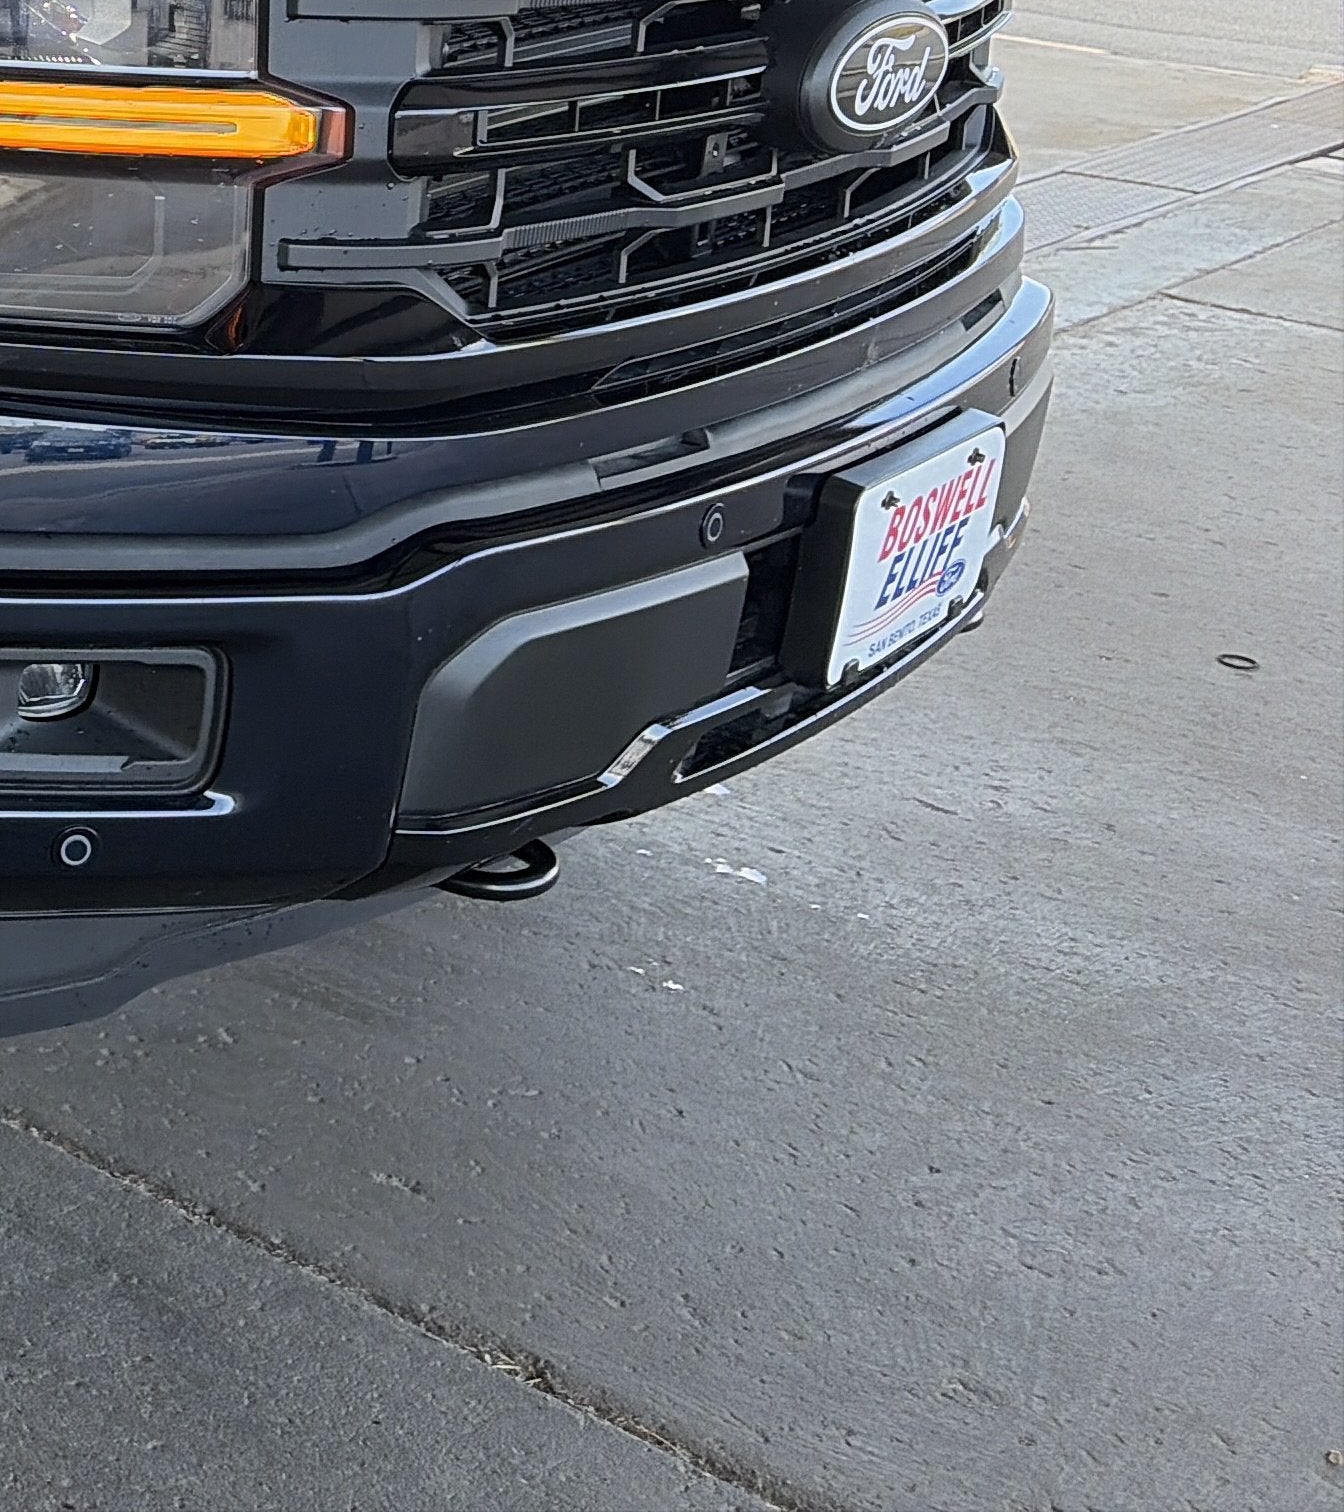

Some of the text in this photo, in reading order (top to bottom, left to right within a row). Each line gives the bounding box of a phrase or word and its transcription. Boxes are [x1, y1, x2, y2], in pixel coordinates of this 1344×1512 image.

[854, 34, 932, 117] Ford
[877, 458, 996, 562] BOSWELL
[873, 515, 972, 611] ELLIFF
